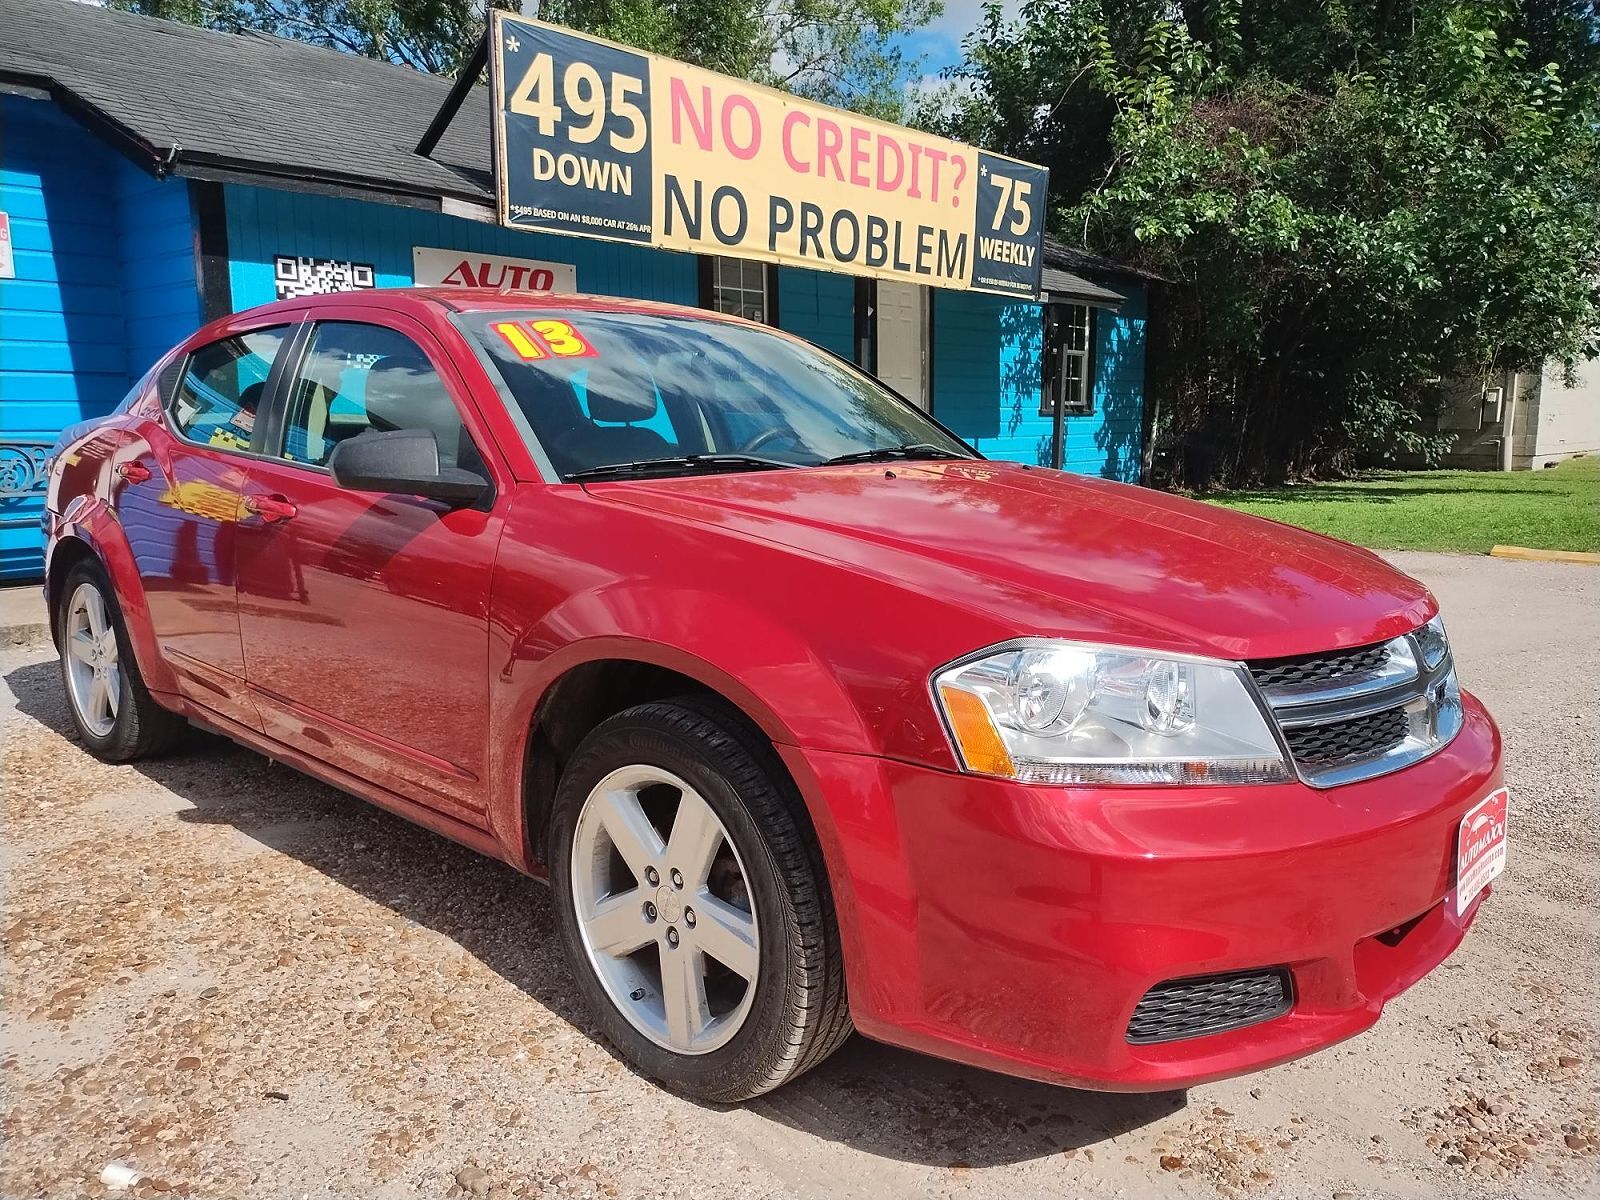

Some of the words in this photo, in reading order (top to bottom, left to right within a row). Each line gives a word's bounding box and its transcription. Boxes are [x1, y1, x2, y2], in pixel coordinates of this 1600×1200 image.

[670, 76, 762, 161] NO
[782, 110, 967, 209] CREDIT?
[533, 147, 632, 196] DOWN
[533, 208, 556, 219] BASED
[558, 211, 570, 221] ON
[570, 213, 581, 223] AN
[581, 215, 603, 226] $8,000
[603, 218, 617, 229] CAR
[616, 219, 626, 230] AT
[638, 223, 652, 234] APR
[664, 173, 748, 246] NO
[768, 194, 968, 280] PROBLEM
[979, 236, 1036, 268] WEEKLY
[441, 260, 554, 291] AUTO
[497, 320, 587, 360] 13
[1460, 820, 1505, 871] AUTOMAXX
